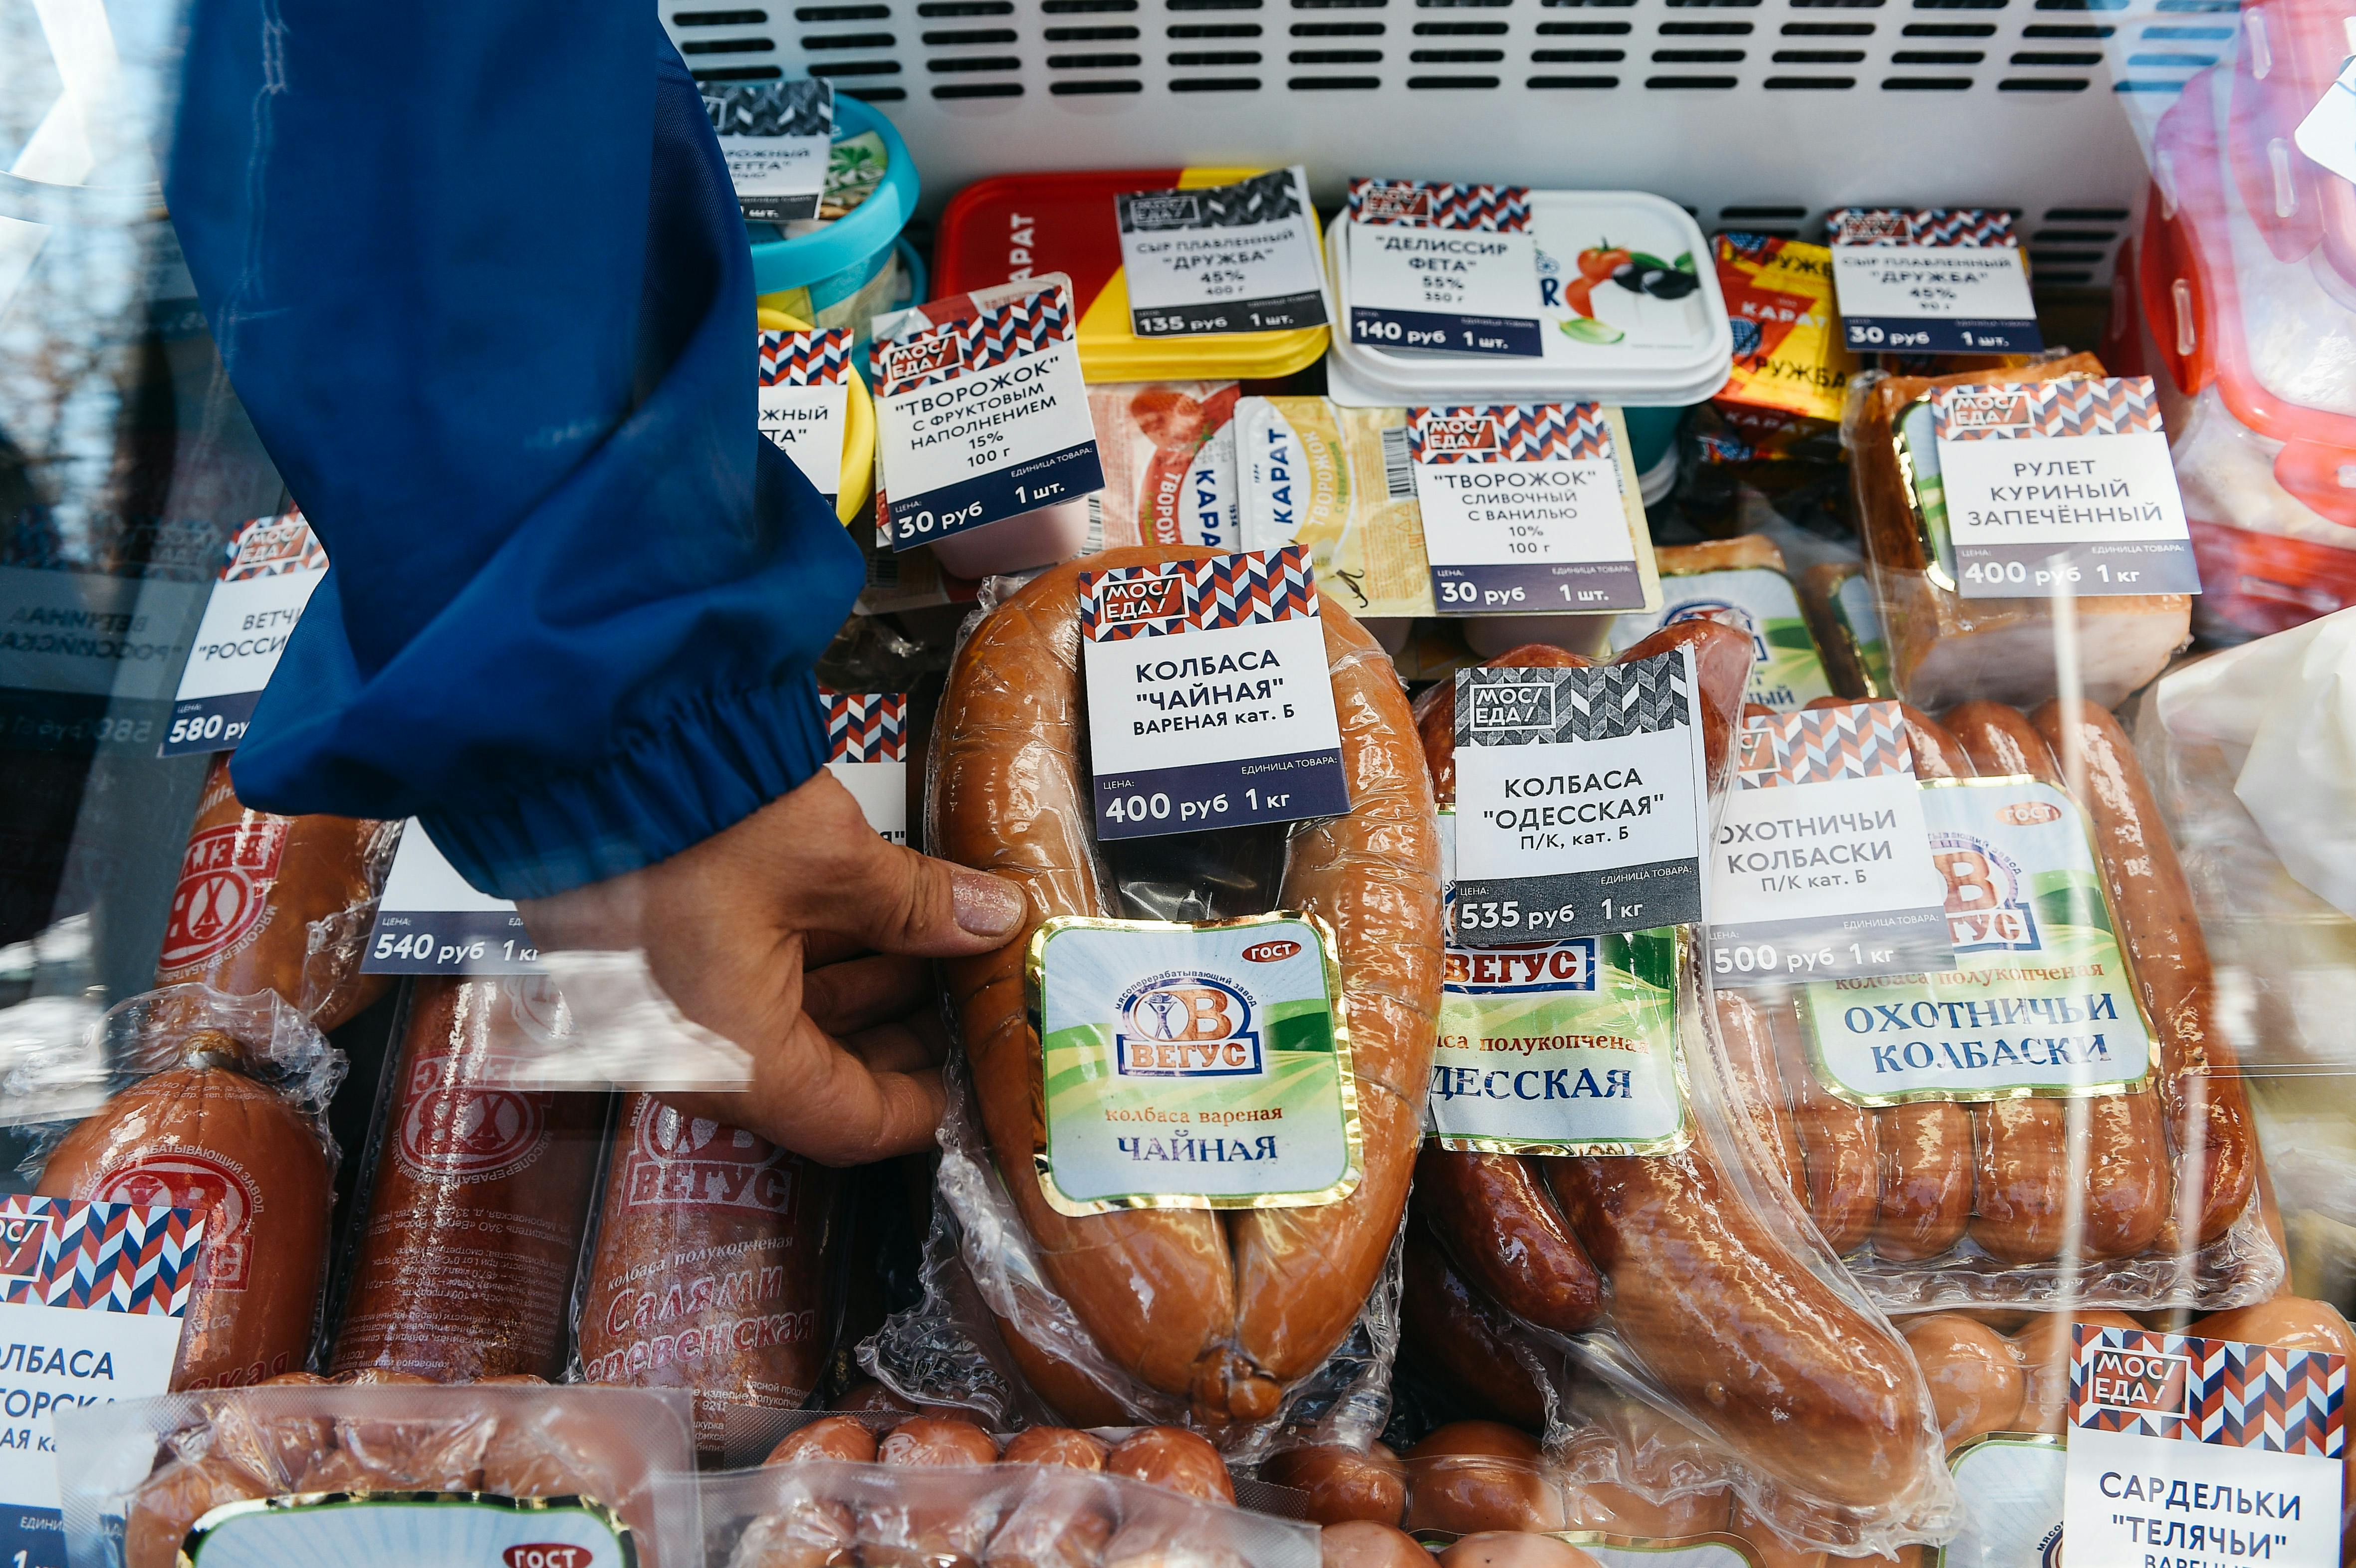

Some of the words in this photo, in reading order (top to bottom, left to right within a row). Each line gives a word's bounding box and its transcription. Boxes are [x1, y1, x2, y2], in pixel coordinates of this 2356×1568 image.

[1008, 213, 1035, 282] АРАТ
[1163, 249, 1274, 270] "ДРУЖБА"
[1376, 236, 1508, 255] "ДЕЛИССИР
[1201, 271, 1245, 283] 45%
[1409, 257, 1476, 271] ФЕТА"
[1870, 271, 1988, 284] "ДРУЖБА"
[1423, 276, 1464, 289] 55%
[1140, 316, 1185, 333] 135
[1191, 317, 1228, 331] руб
[1250, 313, 1260, 326] 1
[1265, 315, 1294, 326] шт.
[1741, 301, 1827, 329] КАРАТ
[1357, 321, 1402, 339] 140
[1408, 330, 1446, 344] руб
[1463, 331, 1473, 346] 1
[1479, 338, 1509, 349] шт.
[1849, 326, 1885, 344] 30
[1890, 331, 1930, 347] руб
[1961, 331, 1973, 347] 1
[1977, 336, 2010, 347] шт.
[895, 356, 1059, 416] "ТВОРОЖОК"
[762, 407, 828, 420] ЖНЫЙ
[913, 420, 926, 432] С
[931, 383, 1044, 426] ФРУКТОВЫМ
[911, 396, 1056, 450] НАПОЛНЕНИЕМ
[968, 431, 1004, 449] 15%
[967, 450, 997, 467] 100
[1003, 448, 1010, 457] г
[2014, 460, 2096, 477] РУЛЕТ
[895, 500, 922, 513] ЦЕНА:
[1011, 458, 1056, 477] ЕДИНИЦА
[1056, 447, 1093, 463] ТОВАРА:
[1268, 428, 1293, 524] КАРАТ
[1301, 430, 1333, 526] ТВОРОЖОК
[1434, 471, 1596, 488] "ТВОРОЖОК"
[1990, 479, 2130, 501] КУРИНЫЙ
[898, 510, 935, 539] 30
[942, 501, 983, 529] руб
[1015, 486, 1027, 503] 1
[1034, 481, 1065, 499] шт.
[1156, 472, 1182, 545] ТВОРОЖ
[1196, 469, 1221, 547] КАРА
[1462, 489, 1577, 505] СЛИВОЧНЫЙ
[1468, 510, 1480, 521] С
[1487, 508, 1577, 520] ВАНИЛЬЮ
[1968, 502, 2163, 526] ЗАПЕЧЁННЫЙ
[1509, 526, 1543, 537] 10%
[1509, 543, 1537, 553] 100
[1965, 561, 2027, 584] 400
[2036, 567, 2082, 586] руб
[2097, 565, 2109, 583] 1
[2119, 570, 2139, 583] кг
[1441, 582, 1477, 602] 30
[1484, 587, 1525, 605] руб
[1560, 585, 1571, 601] 1
[1578, 590, 1609, 601] шт.
[199, 635, 287, 661] "РОССИ
[1137, 650, 1280, 683] КОЛБАСА
[1137, 678, 1284, 711] "ЧАЙНАЯ"
[169, 715, 223, 744] 580
[224, 721, 250, 740] ру
[1133, 712, 1227, 735] ВАРЕНАЯ
[1235, 709, 1276, 725] кат.
[1284, 704, 1295, 718] Б
[1104, 781, 1135, 790] ЦЕНА:
[1241, 761, 1294, 775] ЕДИНИЦА
[1296, 756, 1338, 769] ТОВАРА:
[1505, 768, 1643, 798] КОЛБАСА
[1106, 792, 1171, 823] 400
[1180, 794, 1229, 821] руб
[1245, 788, 1258, 810] 1
[1266, 793, 1290, 808] кг
[1483, 794, 1664, 832] "ОДЕССКАЯ"
[2003, 805, 2052, 822] ГОСТ
[1521, 834, 1565, 851] П/К,
[1573, 833, 1612, 846] кат.
[1619, 826, 1629, 840] Б
[1728, 841, 1893, 874] КОЛБАСКИ
[1460, 887, 1489, 896] ЦЕНА:
[1601, 871, 1650, 886] ЕДИНИЦА
[1652, 866, 1692, 878] ТОВАРА:
[1762, 877, 1802, 892] П/К
[1808, 875, 1849, 889] кат.
[1857, 870, 1867, 883] Б
[1460, 901, 1521, 929] 535
[1528, 904, 1575, 929] руб
[1601, 898, 1612, 919] 1
[1621, 902, 1643, 918] кг
[1844, 916, 1895, 930] ЕДИНИЦА
[1897, 914, 1939, 925] ТОВАРА:
[1948, 913, 2021, 944] ГУС
[373, 934, 434, 960] 540
[437, 941, 485, 964] руб
[503, 938, 514, 961] 1
[1251, 943, 1292, 960] ГОСТ
[1714, 944, 1777, 973] 500
[1786, 947, 1835, 972] руб
[1849, 942, 1862, 965] 1
[1871, 948, 1894, 964] кг
[1114, 969, 1232, 1011] мясоперерабатывающий
[1233, 983, 1258, 1007] завод
[1938, 963, 2105, 987] полукопченая
[1845, 993, 2120, 1034] ОХОТНИЧЬИ
[1131, 1044, 1247, 1068] ВЕГУС
[1871, 1034, 2112, 1074] КОЛБАСКИ
[1431, 1065, 1633, 1101] ДЕССКАЯ
[1105, 1107, 1190, 1123] колбаса
[1198, 1107, 1283, 1127] вареная
[1117, 1129, 1277, 1162] ЧАЙНАЯ
[634, 1165, 788, 1209] ВЕГУС
[607, 1259, 666, 1291] колбаса
[607, 1266, 783, 1338] Салями
[586, 1309, 816, 1383] еревенская
[0, 1344, 114, 1380] ЛБАСА
[2100, 1471, 2301, 1521] САРДЕЛЬКИ
[2113, 1514, 2287, 1560] "ТЕЛЯЧЬИ"
